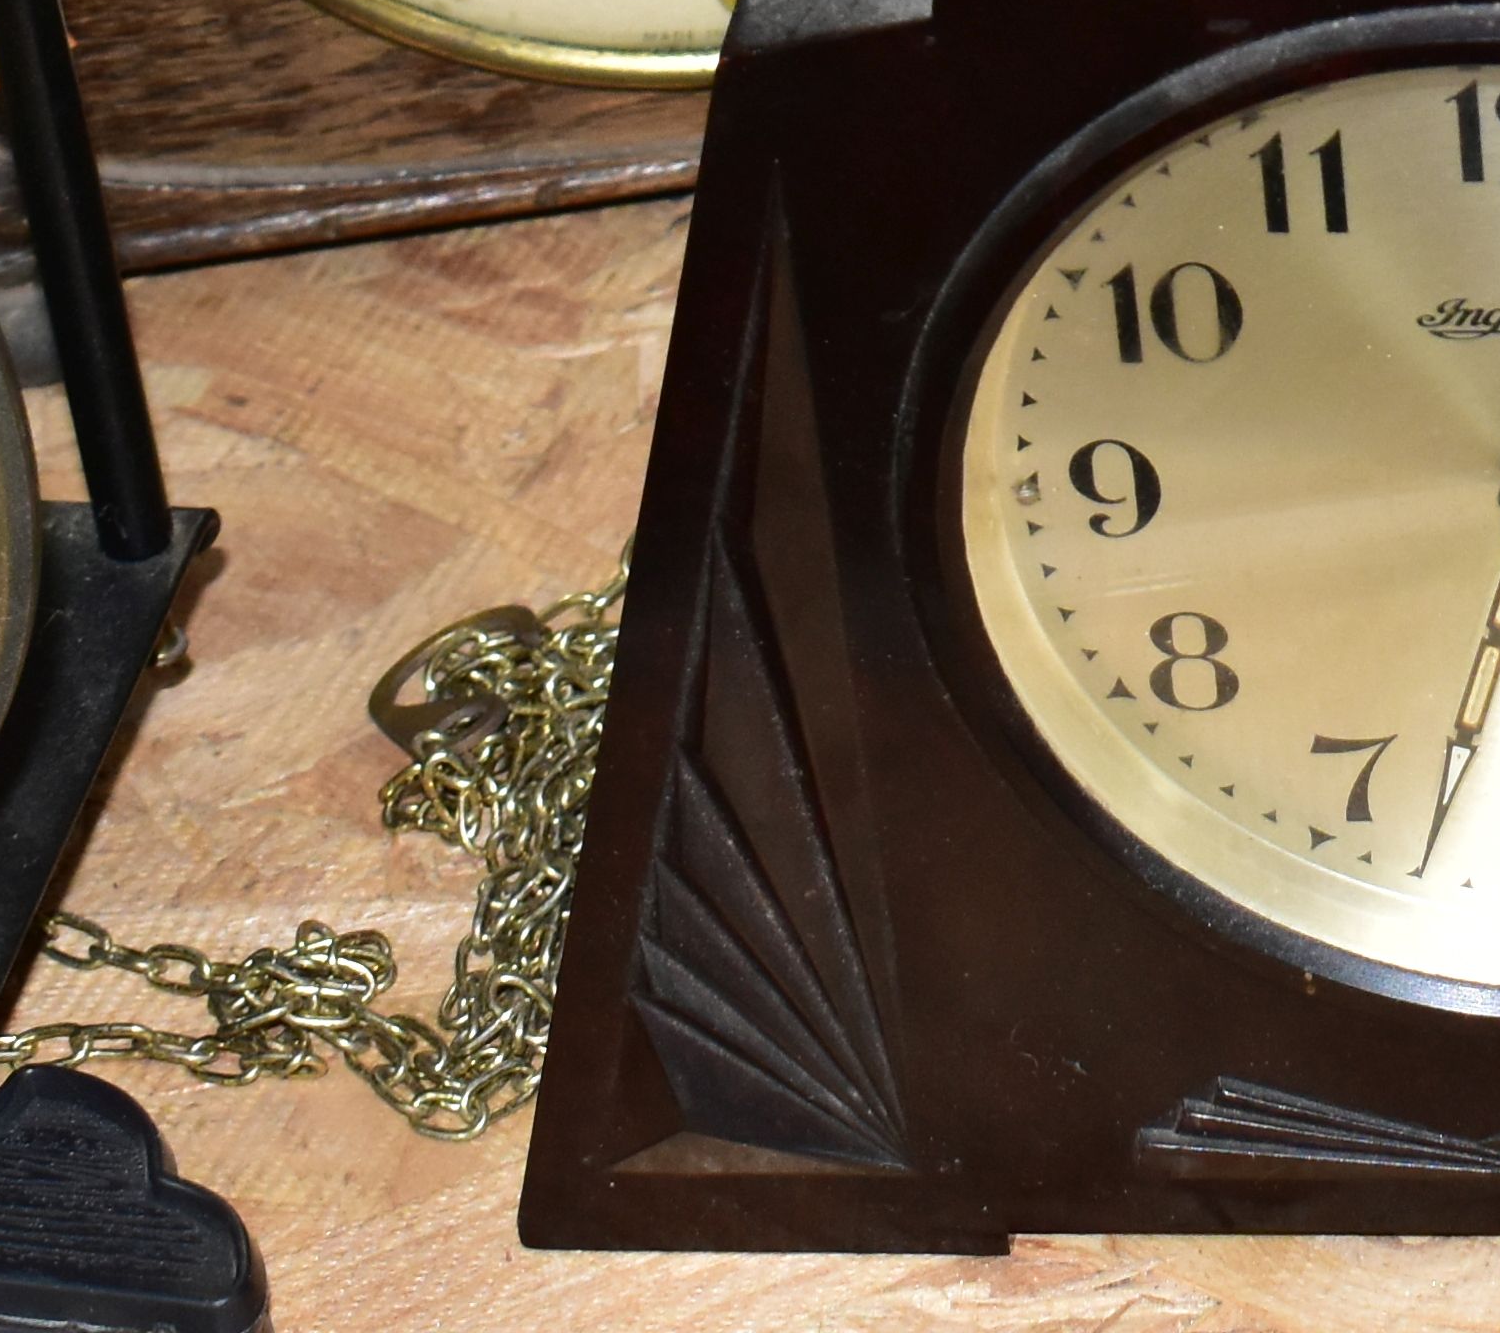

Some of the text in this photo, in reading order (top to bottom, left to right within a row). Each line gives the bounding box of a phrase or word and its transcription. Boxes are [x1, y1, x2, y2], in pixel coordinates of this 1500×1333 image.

[1248, 128, 1351, 237] 11
[1099, 260, 1245, 366] 10
[1067, 438, 1164, 539] 9
[1147, 611, 1241, 713] 8
[1308, 731, 1399, 824] 7
